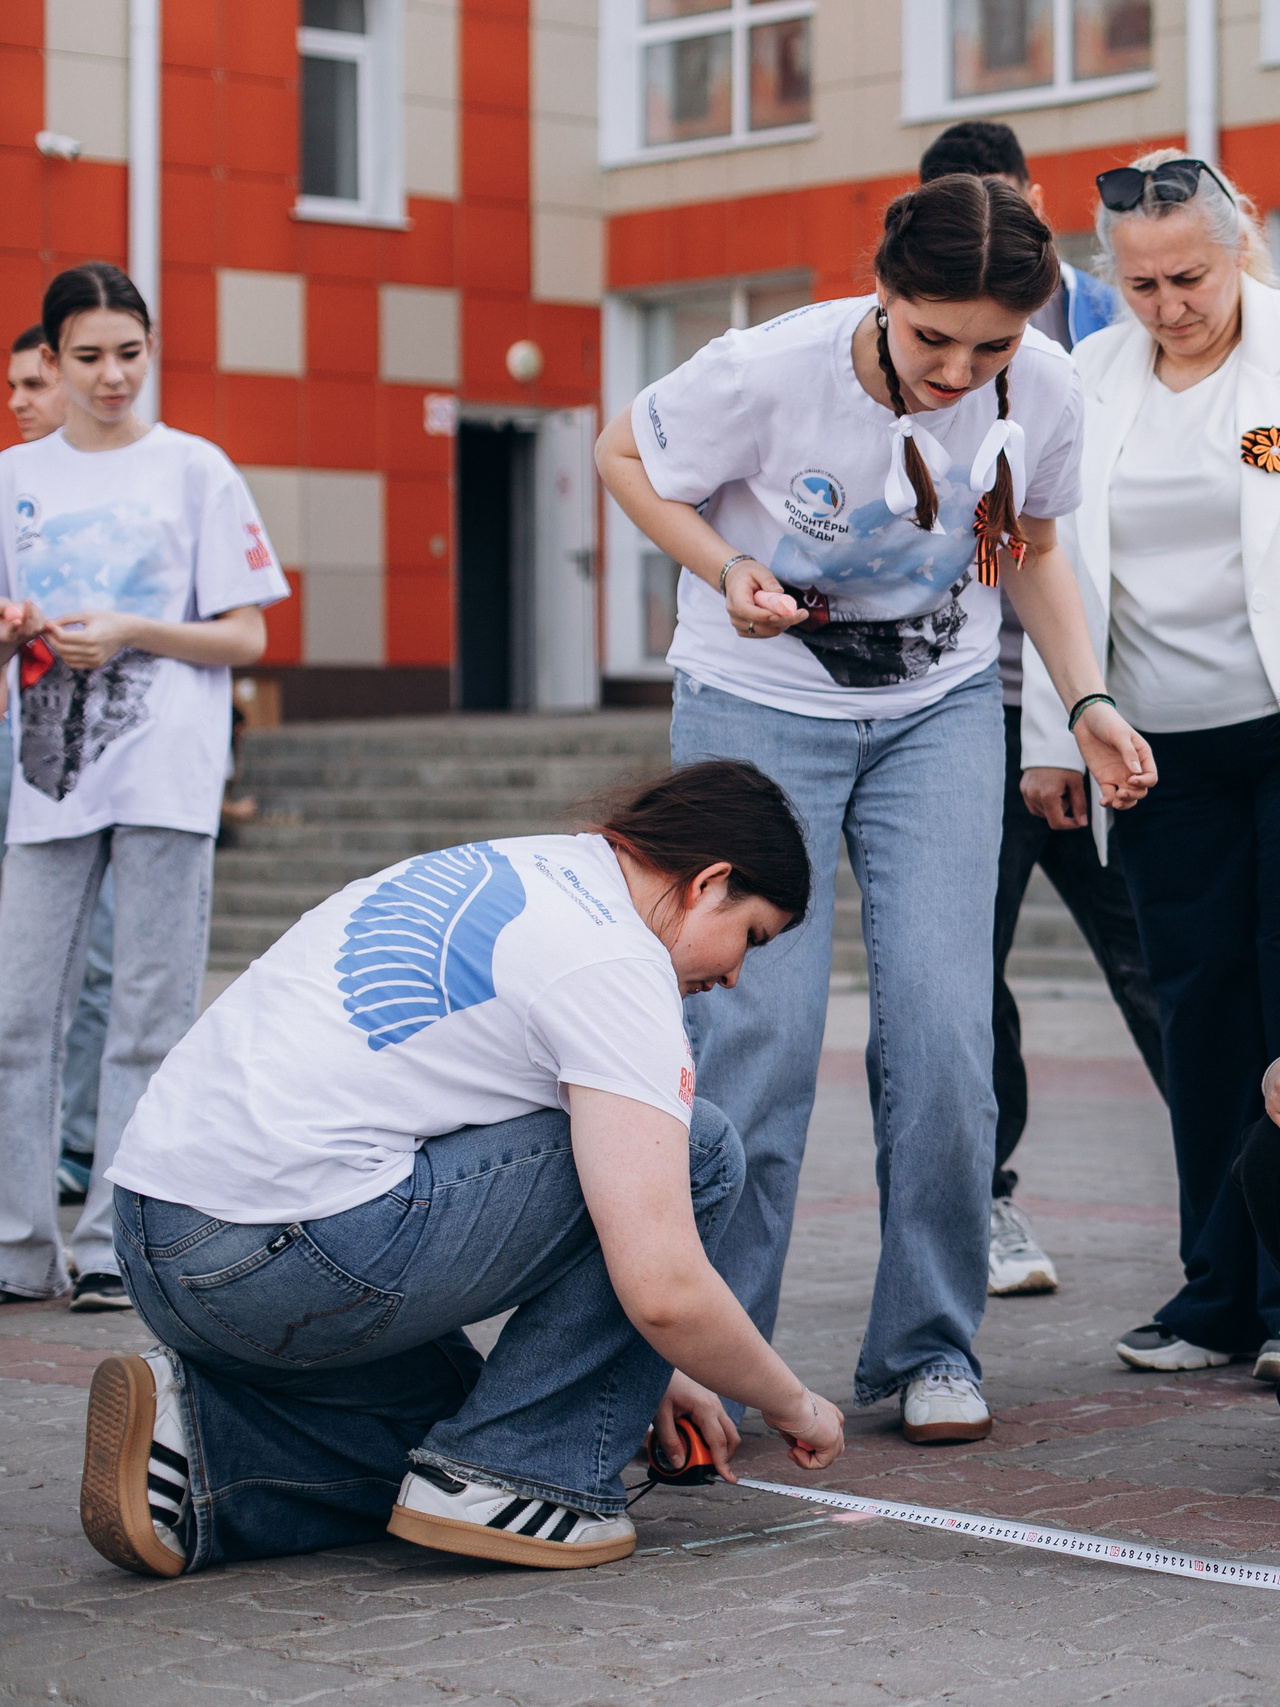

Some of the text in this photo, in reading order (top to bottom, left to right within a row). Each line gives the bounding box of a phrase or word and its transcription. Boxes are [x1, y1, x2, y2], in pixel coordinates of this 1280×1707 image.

[784, 500, 849, 533] ВОЛОНТЁРЫ
[787, 516, 835, 542] ПОБЕДЫ
[1109, 1546, 1120, 1558] 50
[1194, 1559, 1205, 1571] 40
